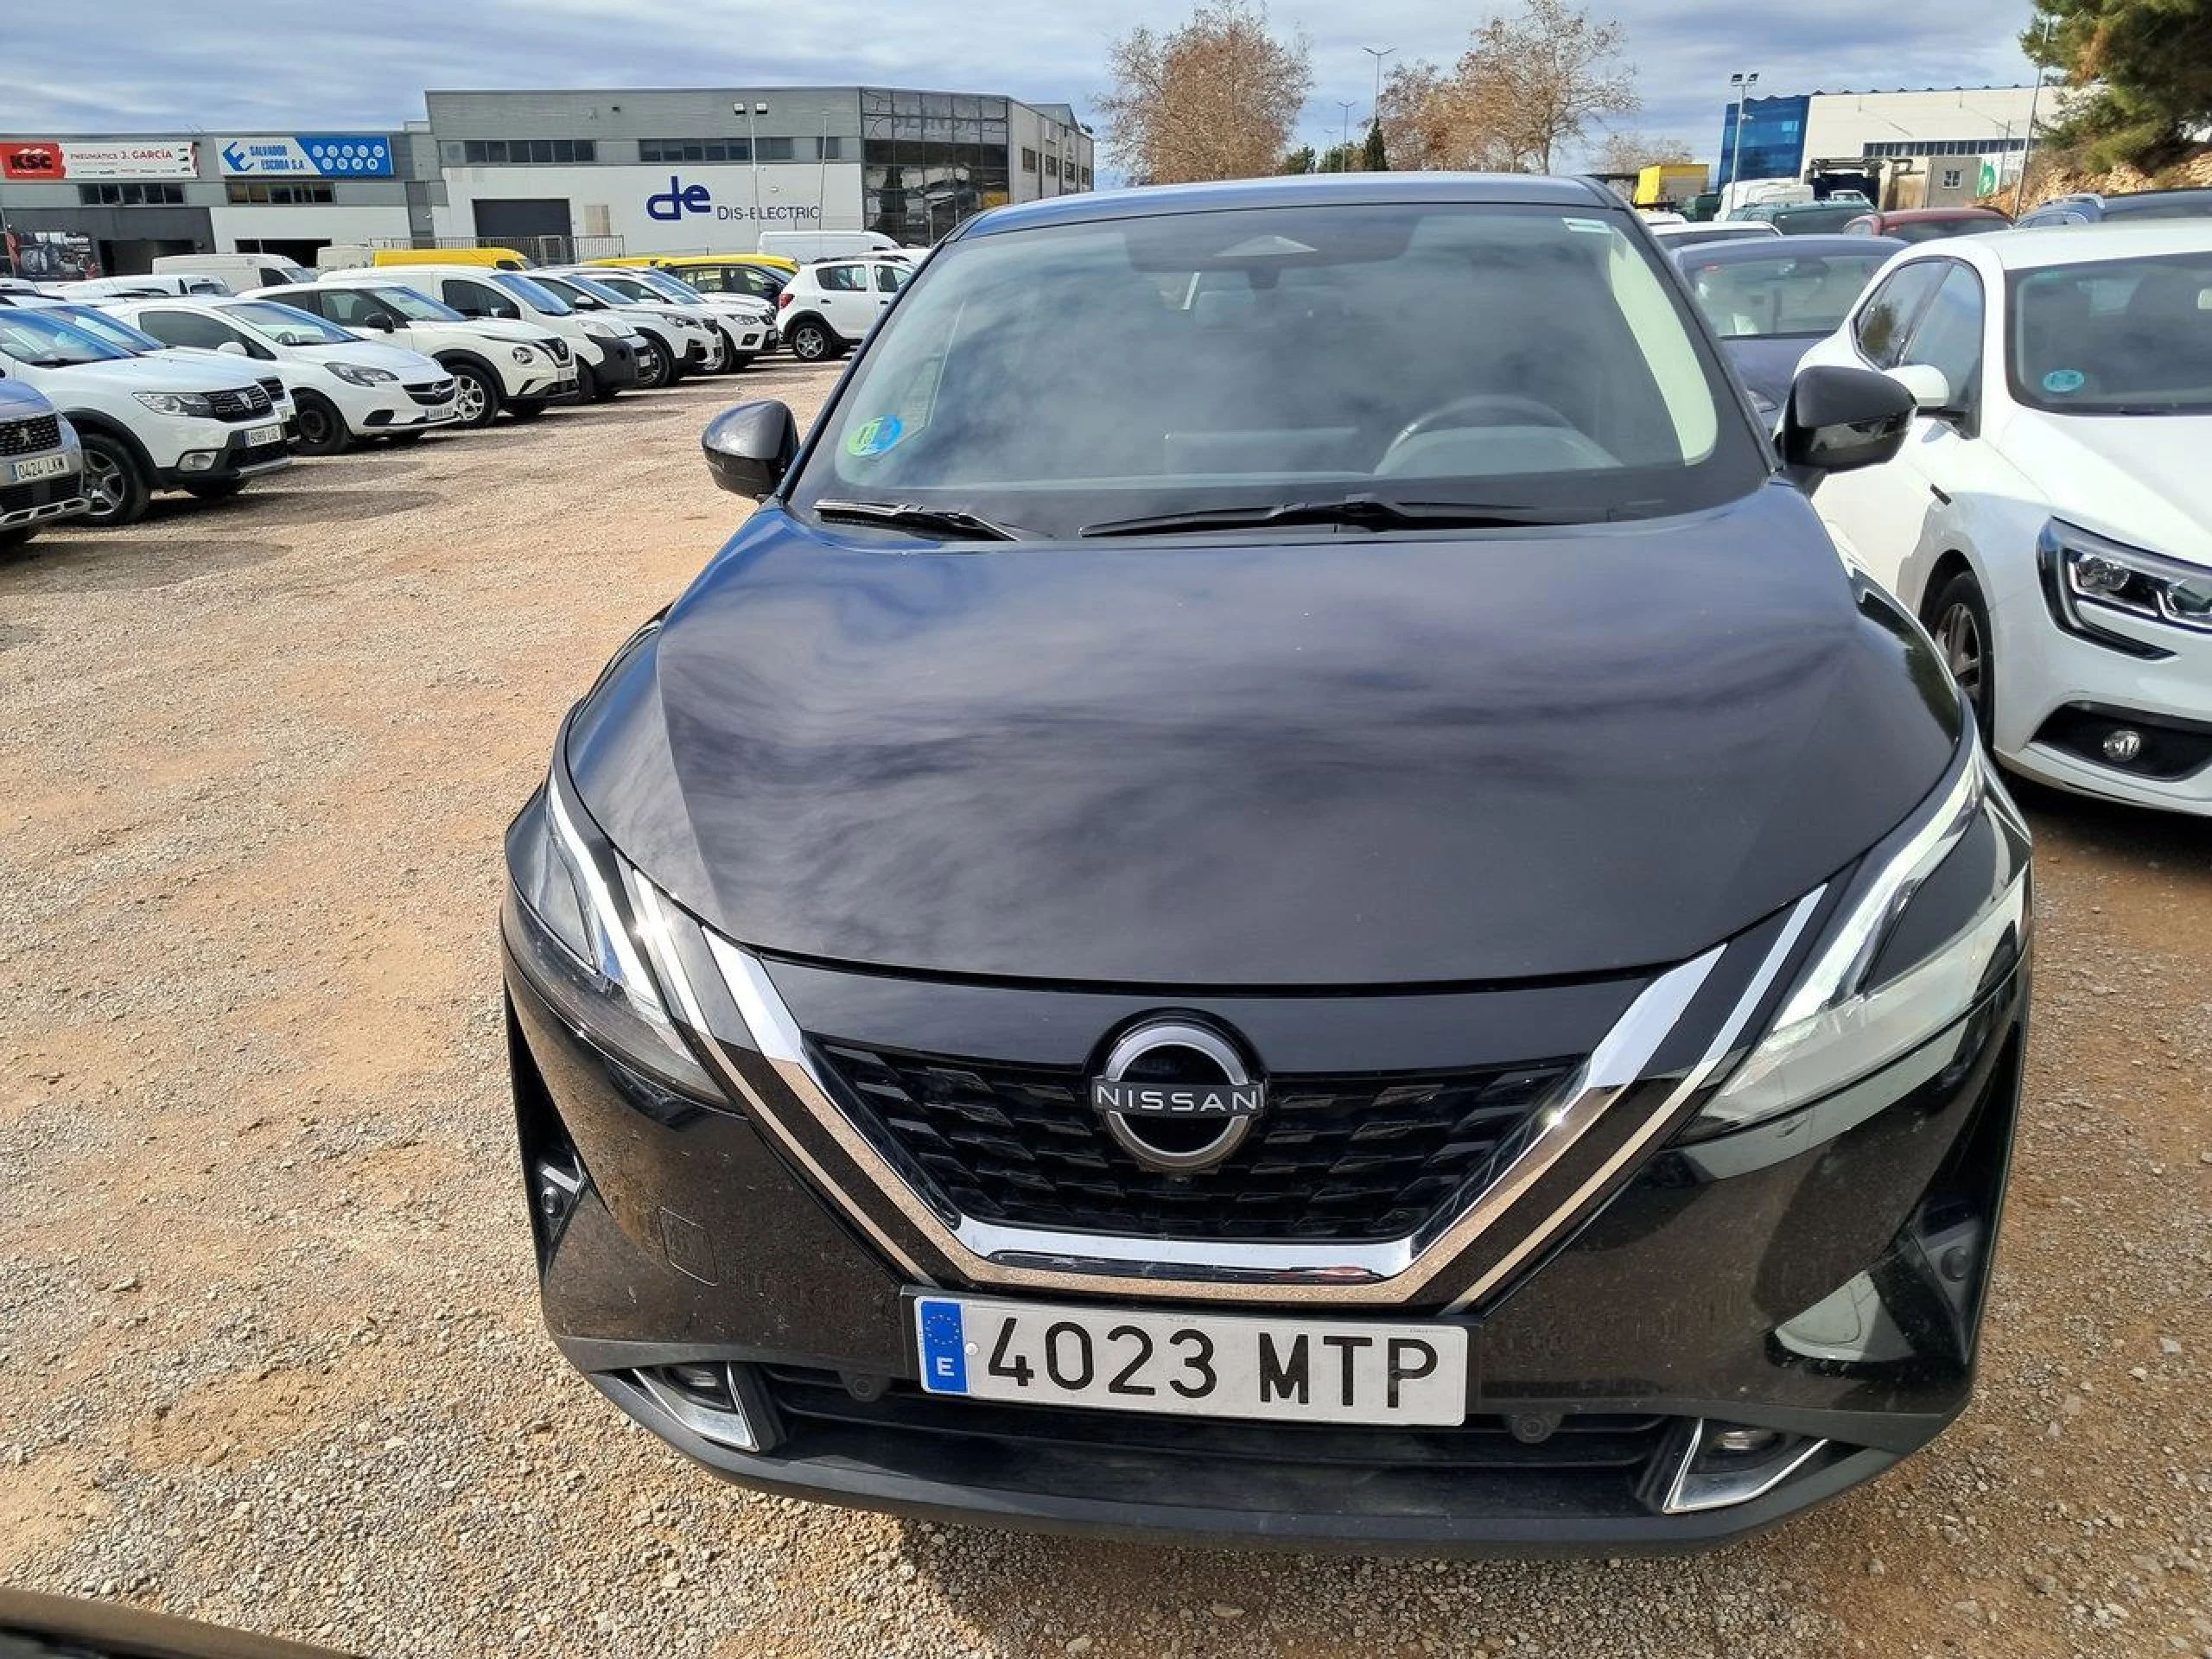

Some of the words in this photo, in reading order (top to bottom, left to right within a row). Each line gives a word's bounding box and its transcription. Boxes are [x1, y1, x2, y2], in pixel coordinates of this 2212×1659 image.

[249, 145, 288, 156] SALVADOR
[10, 154, 54, 169] KSC
[260, 159, 289, 170] ESCODA
[1096, 1084, 1257, 1112] NISSAN
[936, 1356, 955, 1376] E
[988, 1317, 1217, 1399] 4023
[1258, 1332, 1439, 1409] MTP
